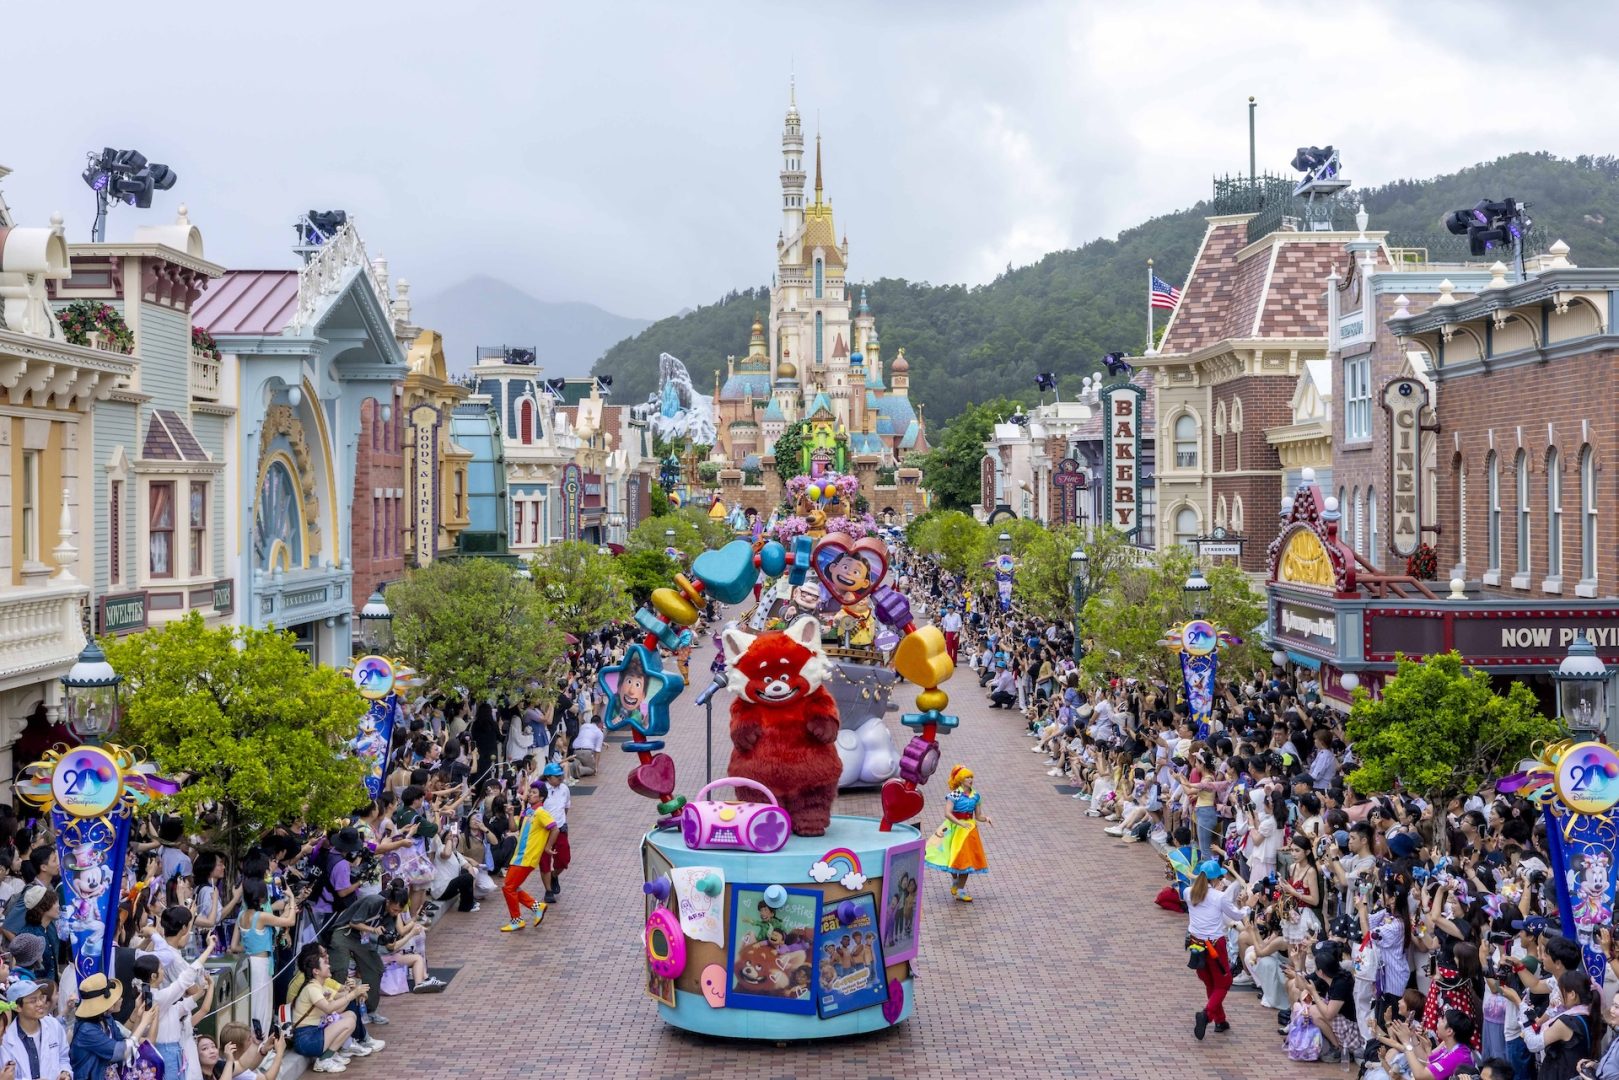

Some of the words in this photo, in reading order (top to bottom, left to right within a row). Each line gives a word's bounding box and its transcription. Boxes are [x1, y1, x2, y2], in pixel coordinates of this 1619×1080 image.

[420, 427, 429, 466] GOODS
[1114, 400, 1135, 524] BAKERY
[1396, 409, 1416, 535] CINEMA
[421, 483, 429, 514] FINE
[420, 519, 429, 558] GIFTS
[105, 600, 143, 626] NOVELTIES
[1502, 628, 1552, 648] NOW
[1560, 627, 1619, 647] PLAYI
